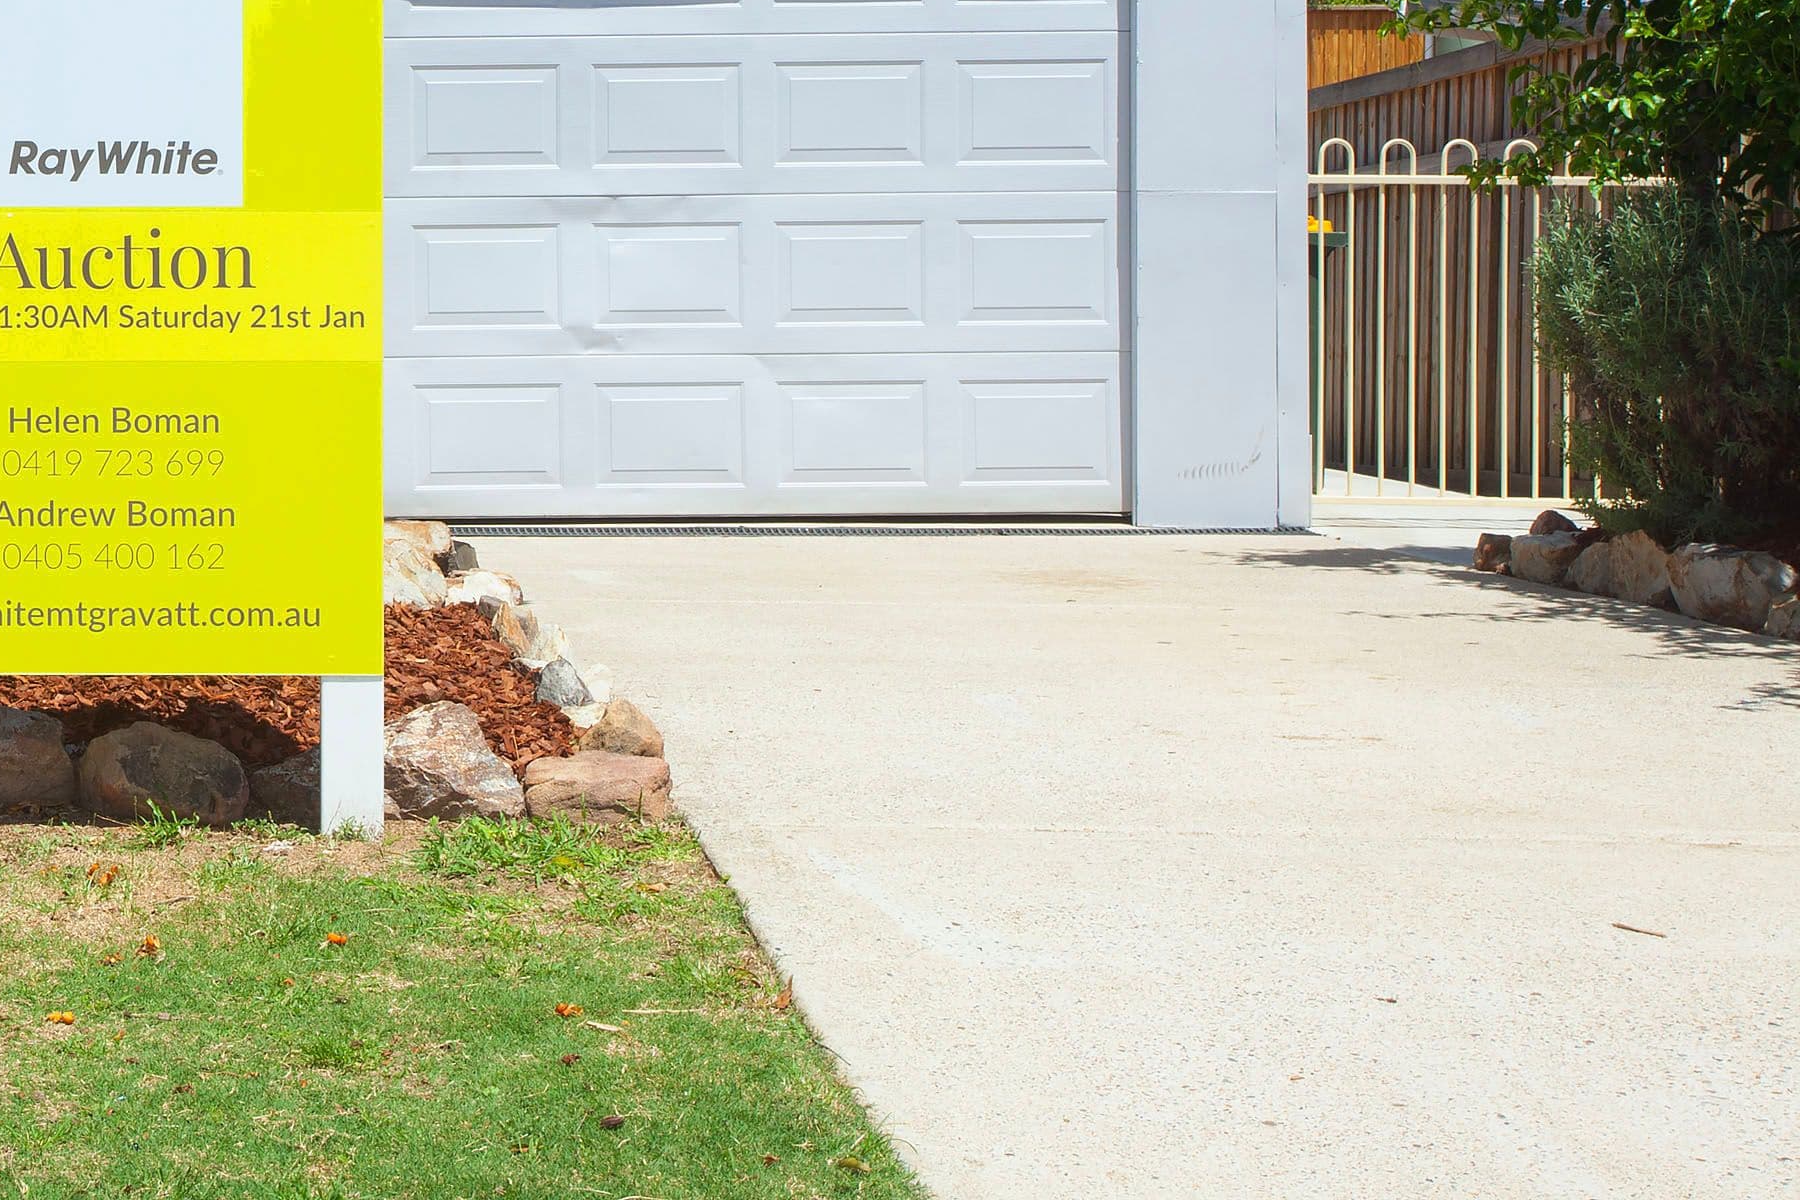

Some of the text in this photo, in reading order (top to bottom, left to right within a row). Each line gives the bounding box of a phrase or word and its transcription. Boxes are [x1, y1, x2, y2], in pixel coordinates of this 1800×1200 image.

[118, 304, 242, 334] Saturday
[250, 304, 312, 329] 21st
[319, 304, 365, 329] Jan
[9, 406, 220, 434] Helen Boman
[1, 448, 225, 477] 0419 723 699
[127, 499, 236, 528] Boman
[1, 542, 225, 570] 0405 400 162
